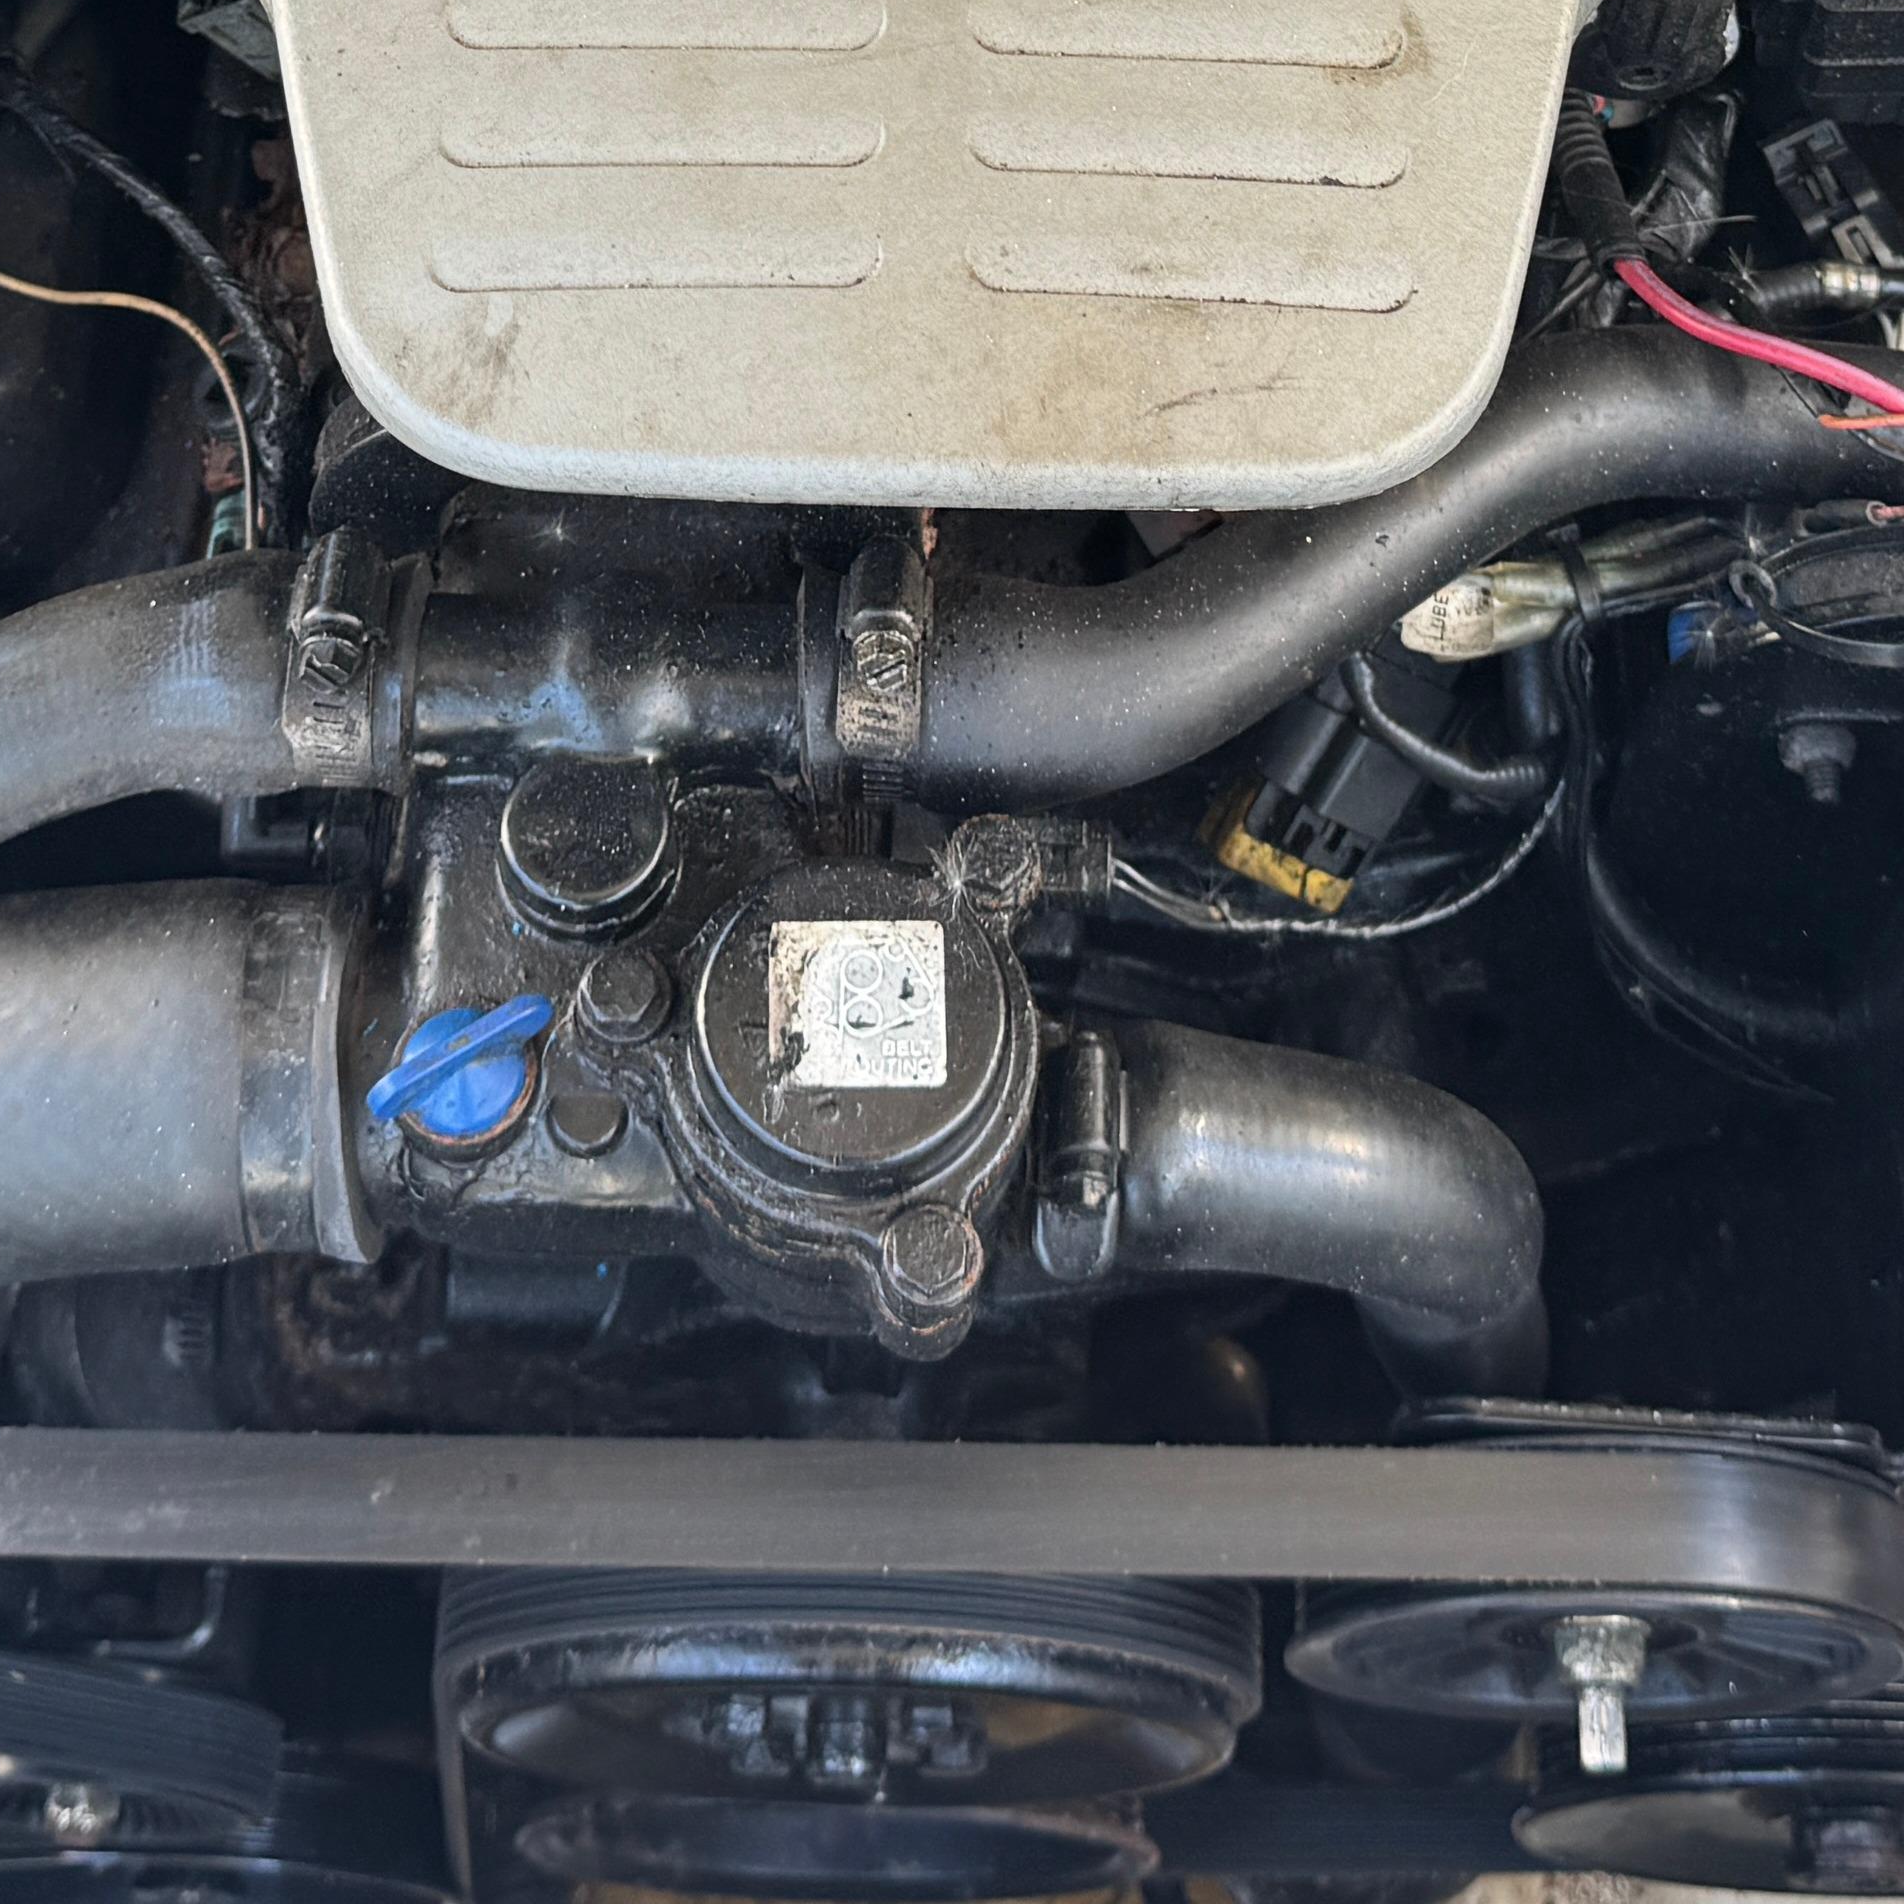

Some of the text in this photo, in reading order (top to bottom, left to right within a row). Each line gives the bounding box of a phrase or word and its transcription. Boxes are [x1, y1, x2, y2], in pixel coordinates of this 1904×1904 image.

[1431, 593, 1449, 641] LUBE
[882, 1039, 933, 1057] BELT
[848, 1057, 933, 1078] OUTING
